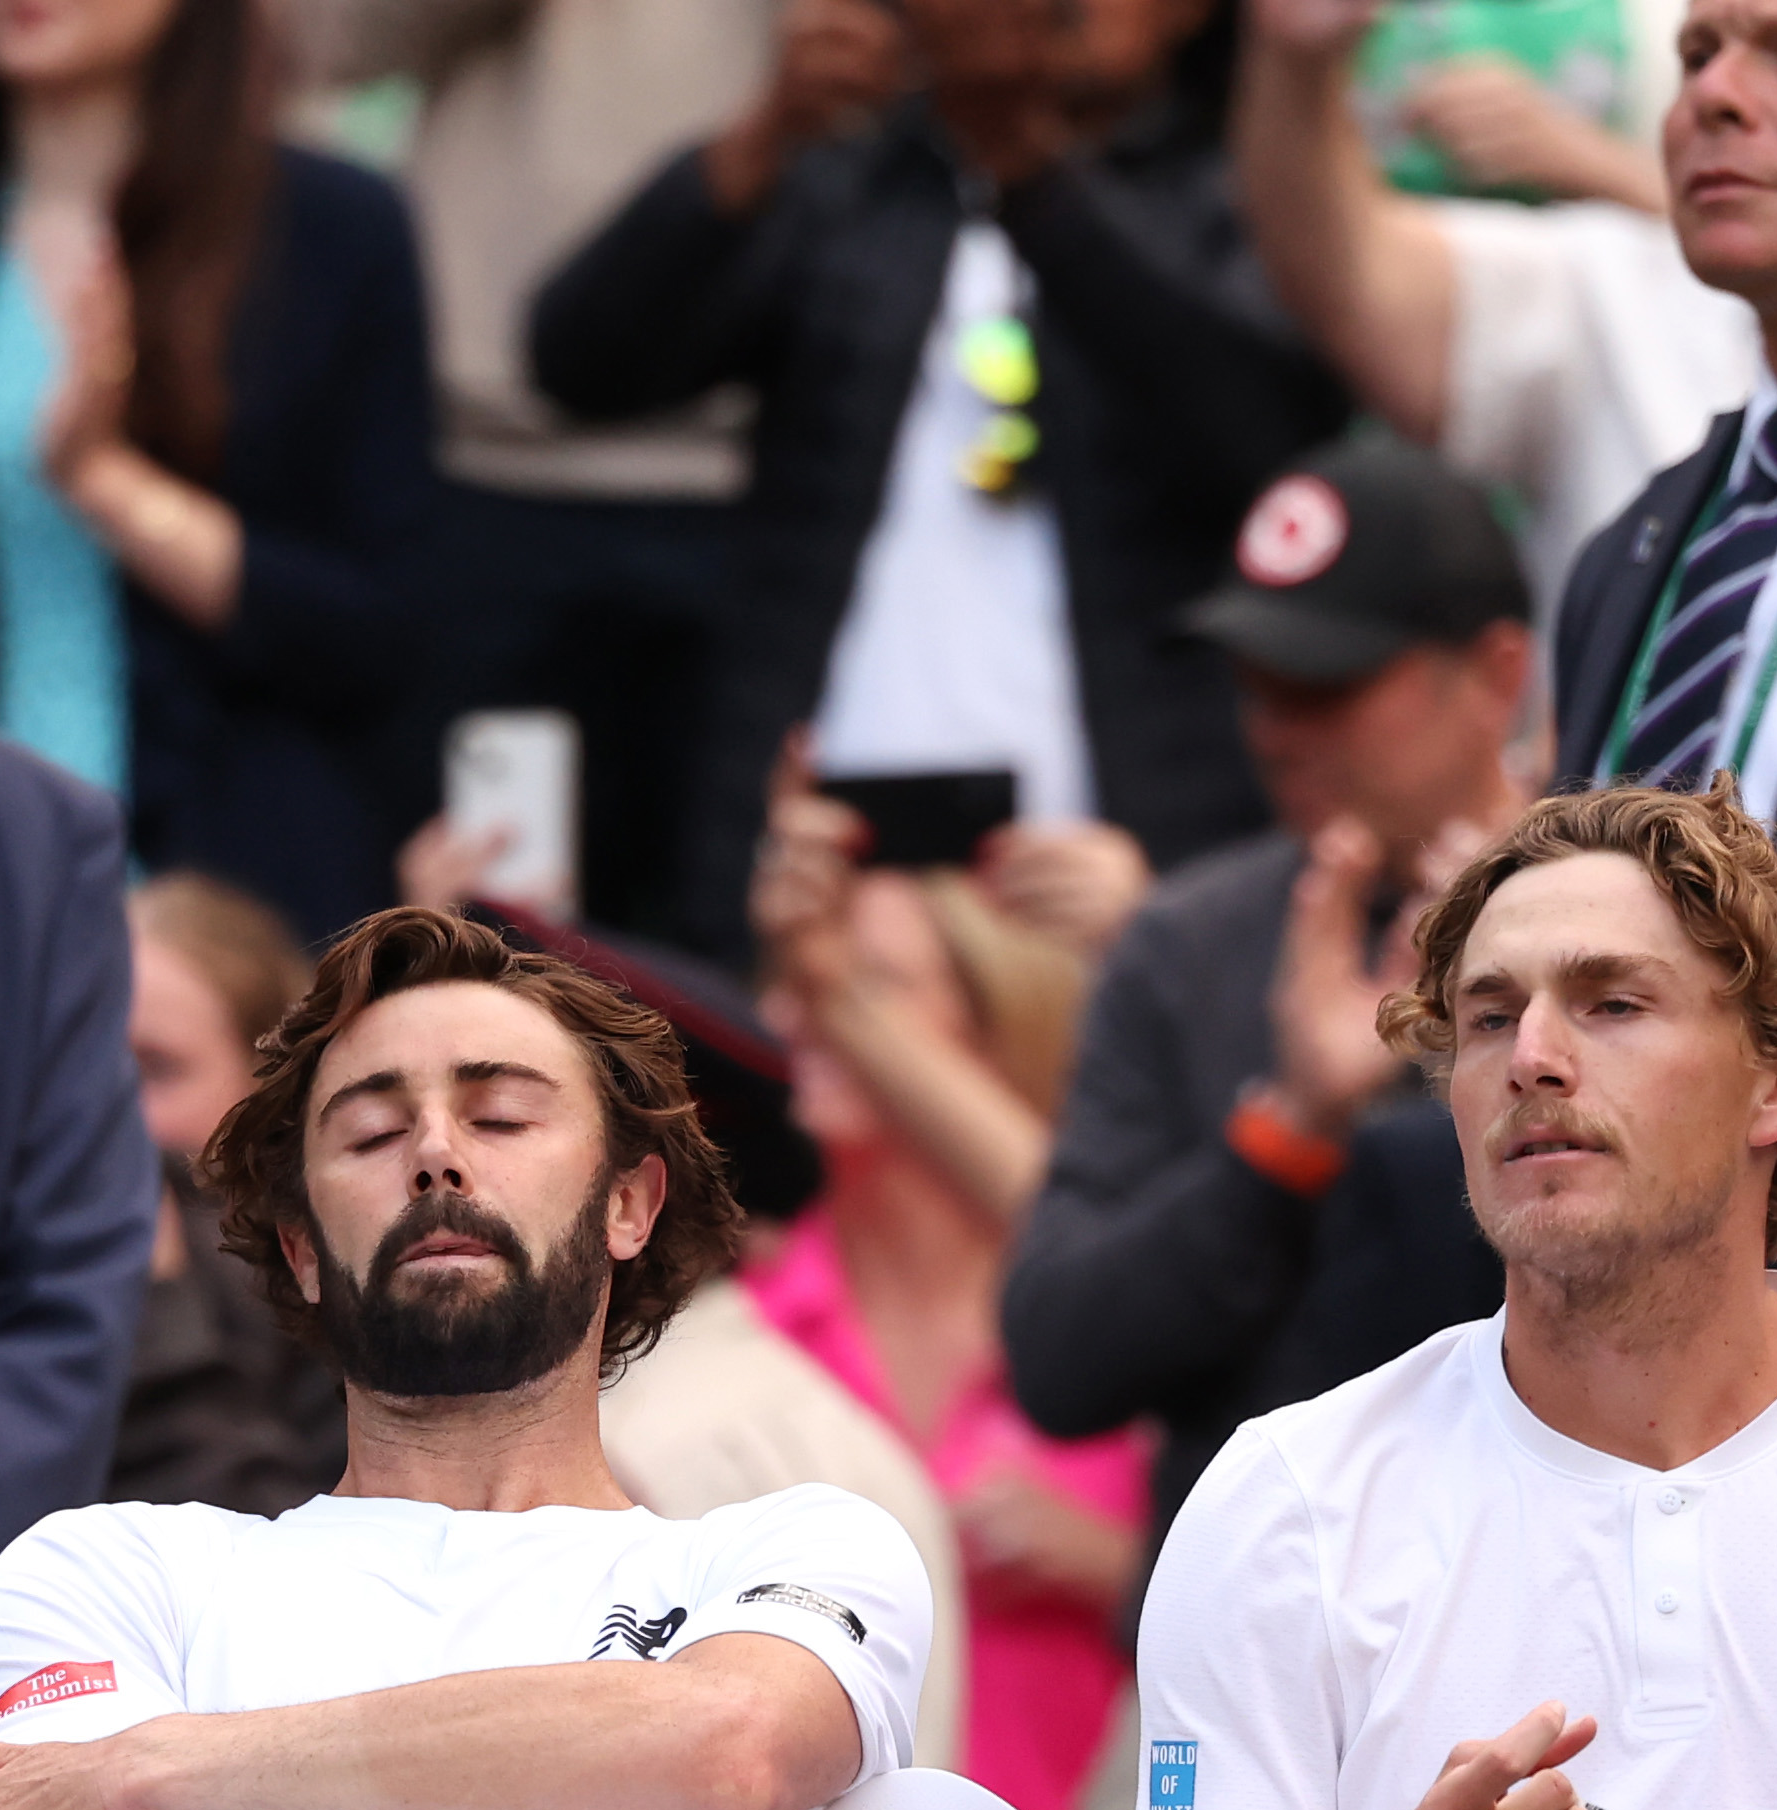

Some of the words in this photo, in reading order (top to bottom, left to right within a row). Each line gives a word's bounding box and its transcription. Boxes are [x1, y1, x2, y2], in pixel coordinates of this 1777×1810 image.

[27, 1668, 67, 1692] The
[1151, 1744, 1195, 1765] WORLD
[1161, 1774, 1179, 1795] OF
